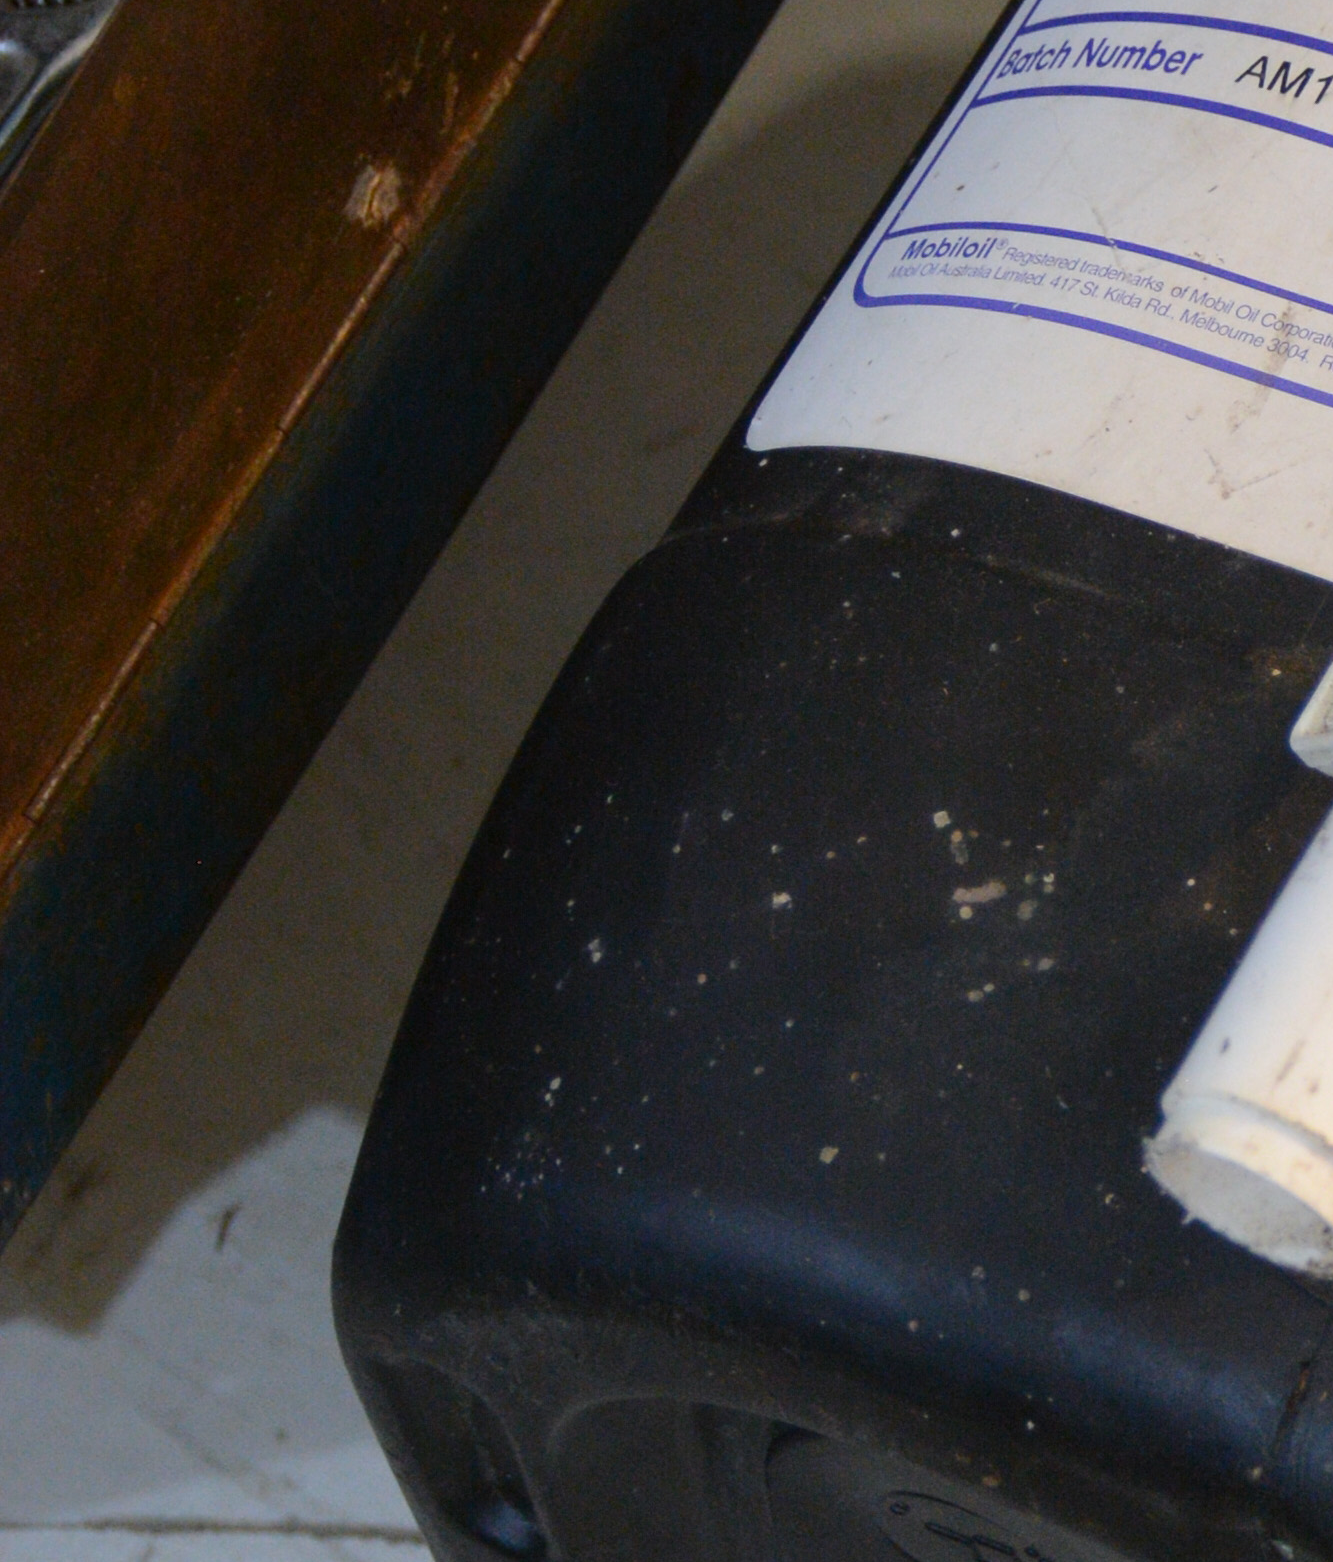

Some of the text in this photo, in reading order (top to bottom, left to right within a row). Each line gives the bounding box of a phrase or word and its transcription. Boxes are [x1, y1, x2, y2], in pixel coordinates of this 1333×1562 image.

[998, 39, 1070, 79] Batch
[1072, 36, 1204, 76] Number
[888, 263, 919, 279] Mobil
[919, 262, 938, 277] Oil
[938, 263, 992, 281] Australia
[1049, 274, 1080, 293] 417
[1103, 287, 1143, 310] Kilda
[1178, 308, 1266, 349] Melbourne
[1003, 247, 1079, 273] Registered
[1080, 260, 1165, 293] trademarks
[1170, 284, 1191, 299] of
[1189, 287, 1235, 316] Mobil
[1236, 303, 1261, 323] Oil
